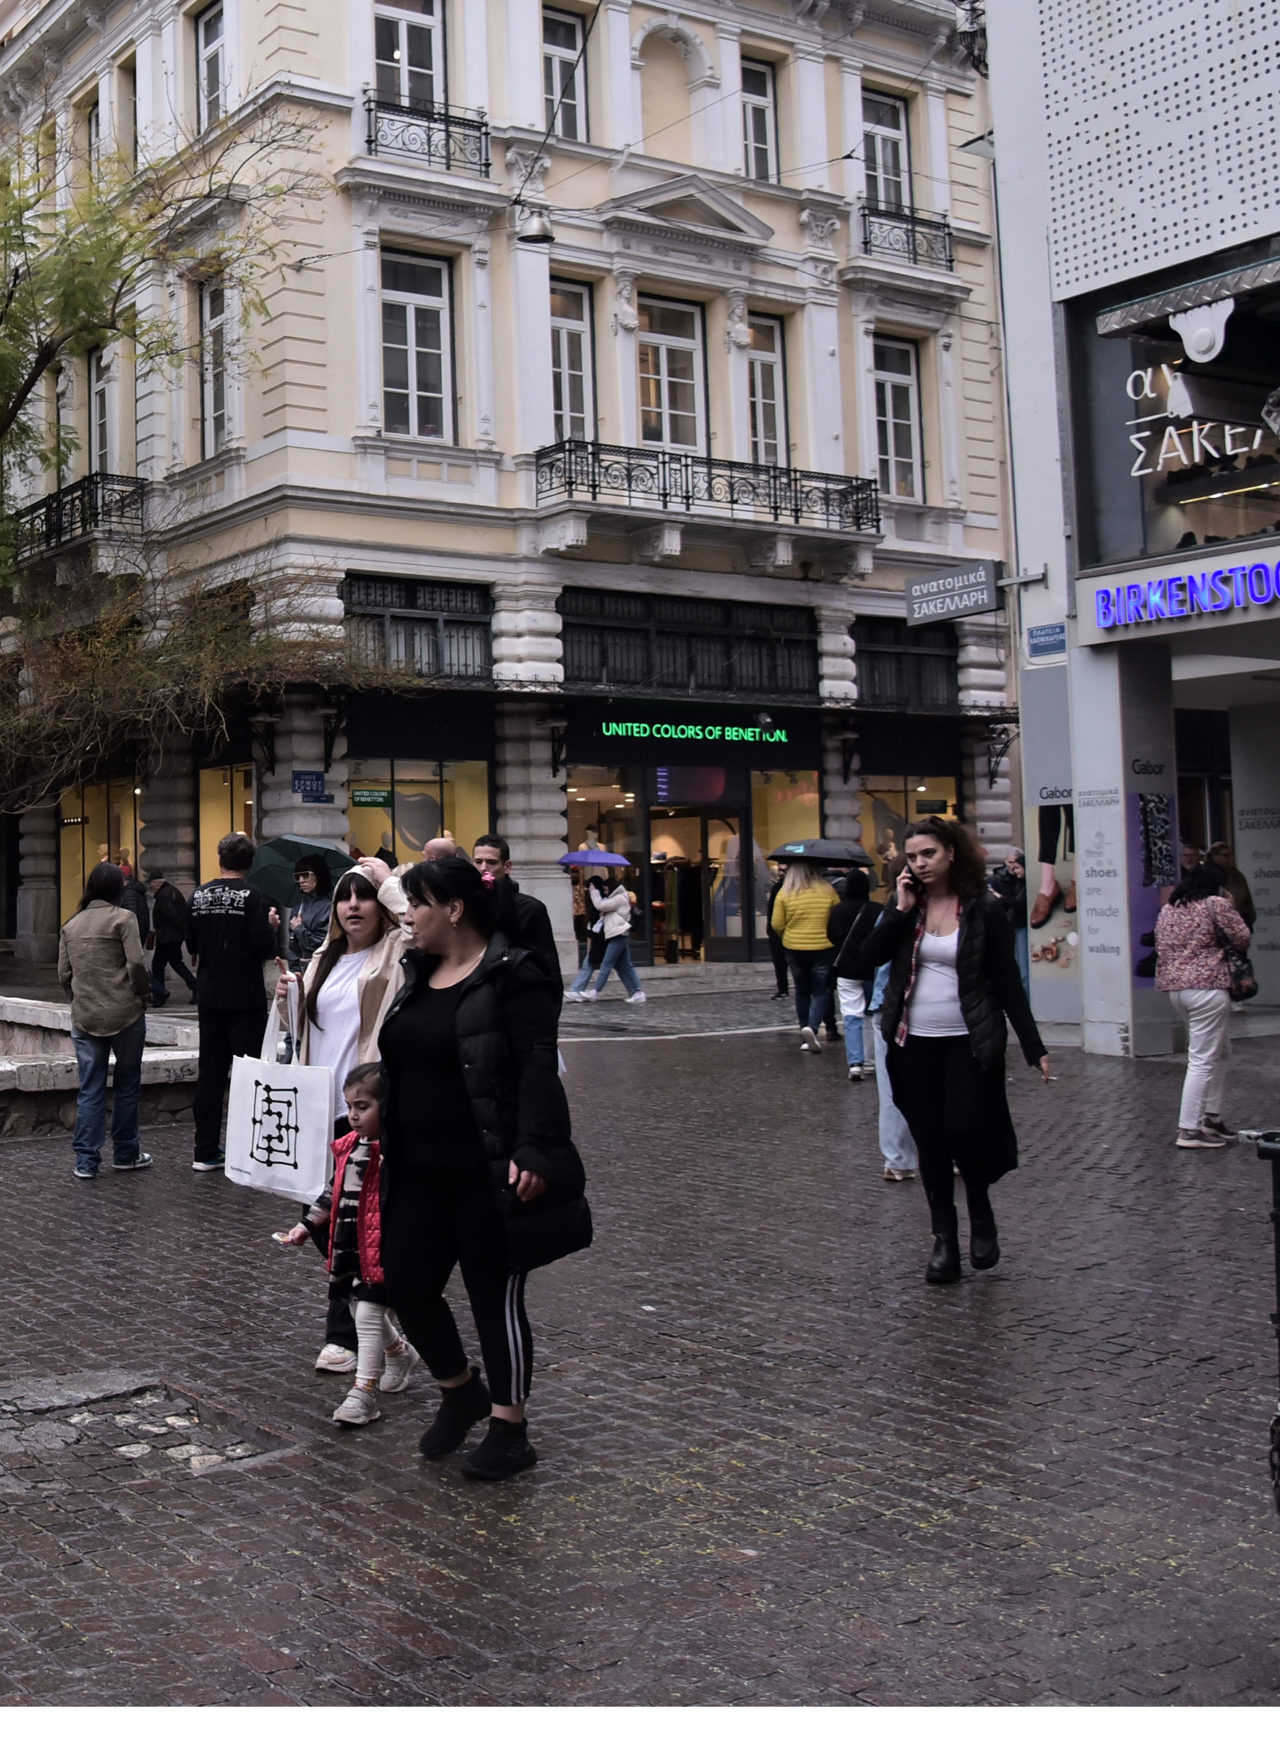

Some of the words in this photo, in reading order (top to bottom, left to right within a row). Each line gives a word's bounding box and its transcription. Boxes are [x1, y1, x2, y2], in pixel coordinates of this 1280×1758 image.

[911, 566, 987, 596] ανατομικά
[912, 589, 988, 618] ΣΑΚΕΛΛΑΡΗ
[602, 722, 651, 738] UNITED
[652, 723, 703, 740] COLORS
[704, 726, 723, 740] OF
[1131, 758, 1165, 775] Gabor
[1039, 786, 1073, 800] Gabor
[1084, 866, 1118, 878] shoes
[1086, 904, 1120, 918] made
[1087, 944, 1121, 956] walking
